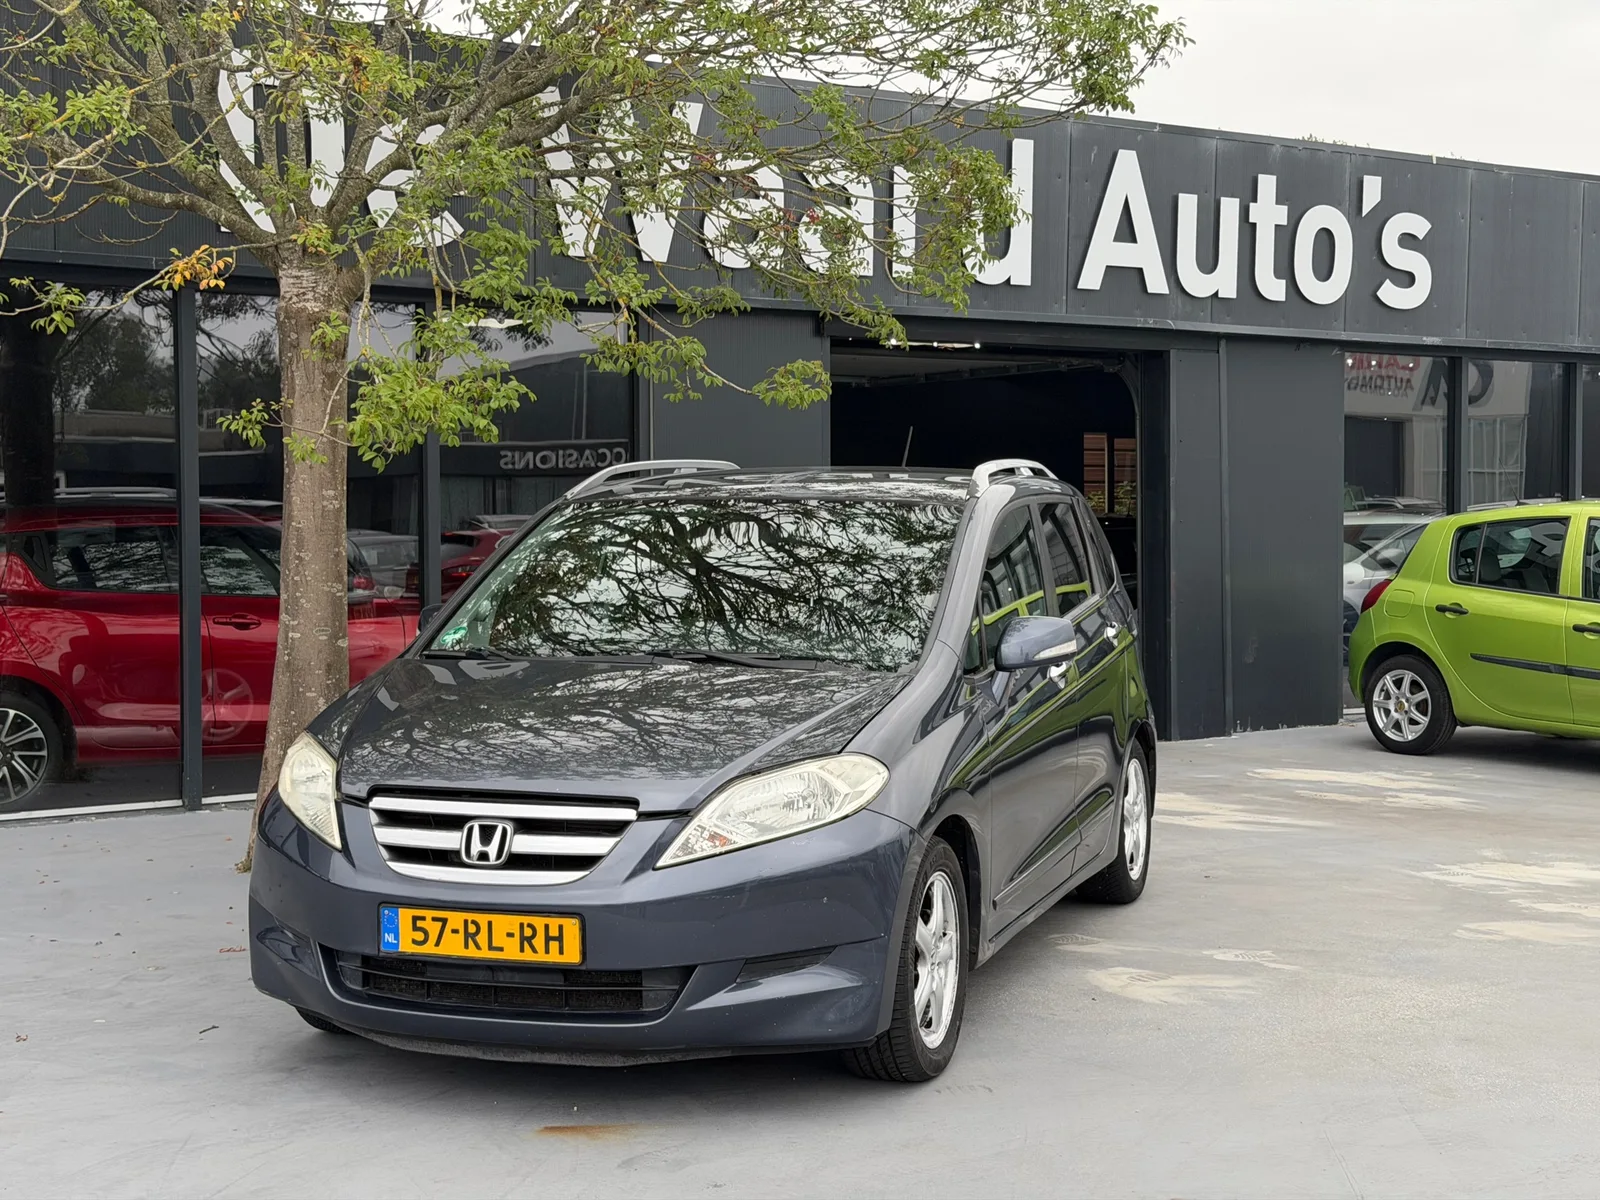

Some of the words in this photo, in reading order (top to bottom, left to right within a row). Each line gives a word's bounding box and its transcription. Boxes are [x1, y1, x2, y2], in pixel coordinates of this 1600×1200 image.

[1077, 149, 1432, 309] Auto's
[384, 932, 398, 944] NL
[411, 914, 565, 956] 57-RL-RH
